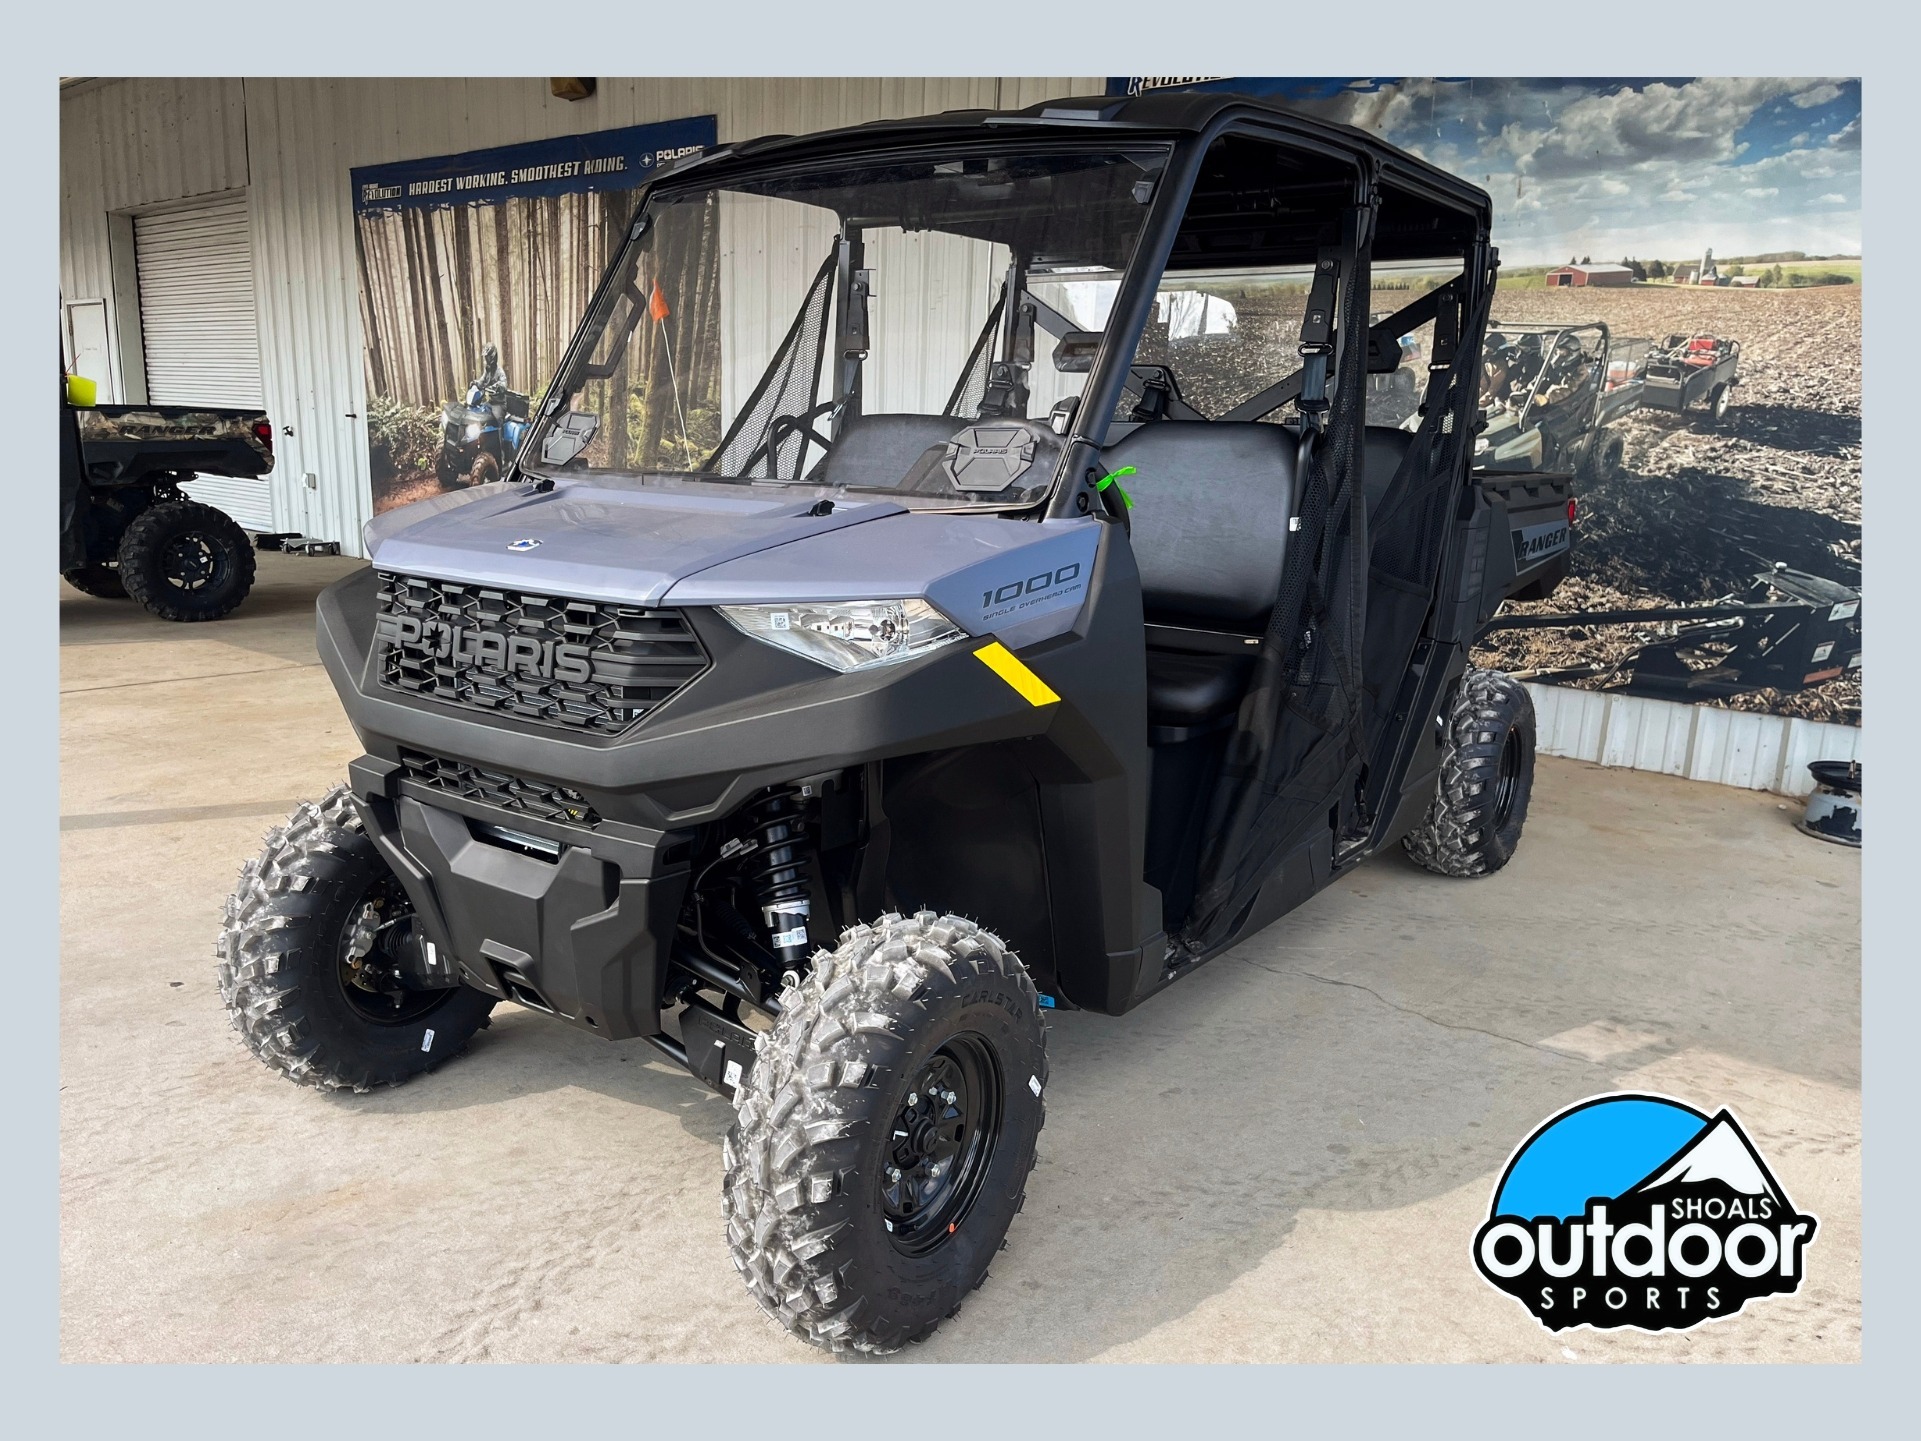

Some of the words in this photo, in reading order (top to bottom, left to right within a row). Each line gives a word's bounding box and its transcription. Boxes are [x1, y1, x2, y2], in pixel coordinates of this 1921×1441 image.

[409, 178, 453, 196] HARDEST
[456, 171, 509, 190] WORKING.
[511, 161, 581, 184] SMOOTHEST
[118, 425, 217, 436] RANGER
[1519, 528, 1567, 557] RANGER
[982, 562, 1081, 609] 1000
[983, 605, 1016, 621] SINGLE
[1018, 590, 1063, 610] OVERHEAD
[1064, 583, 1082, 595] CAM
[395, 612, 595, 684] POLARIS
